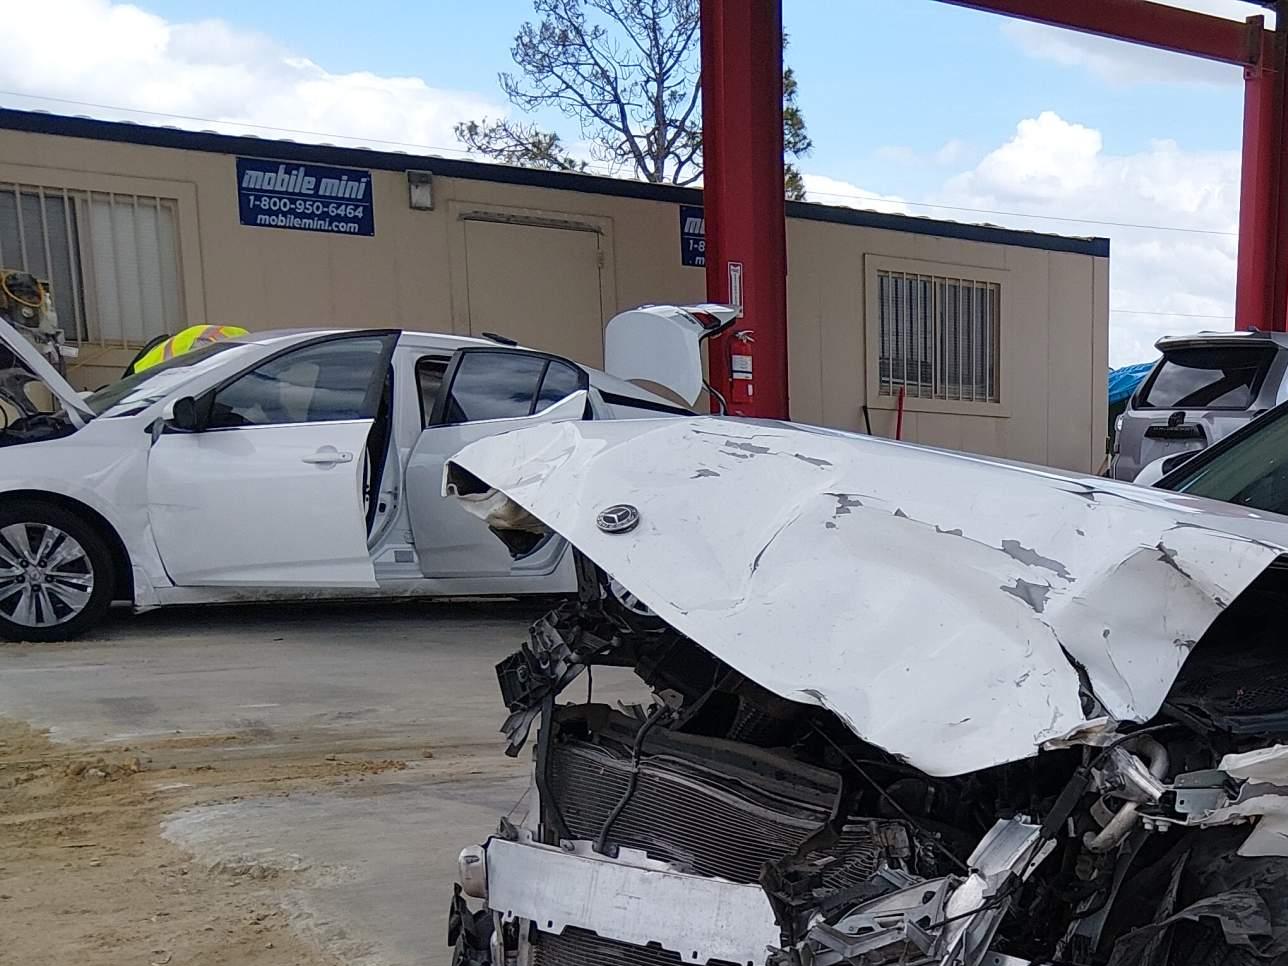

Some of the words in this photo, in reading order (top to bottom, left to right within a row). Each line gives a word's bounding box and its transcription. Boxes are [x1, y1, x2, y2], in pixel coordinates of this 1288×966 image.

[242, 164, 316, 195] mobile
[318, 175, 367, 199] mini
[248, 195, 363, 218] 1-800-950-6464
[256, 214, 359, 232] mobilemini.com
